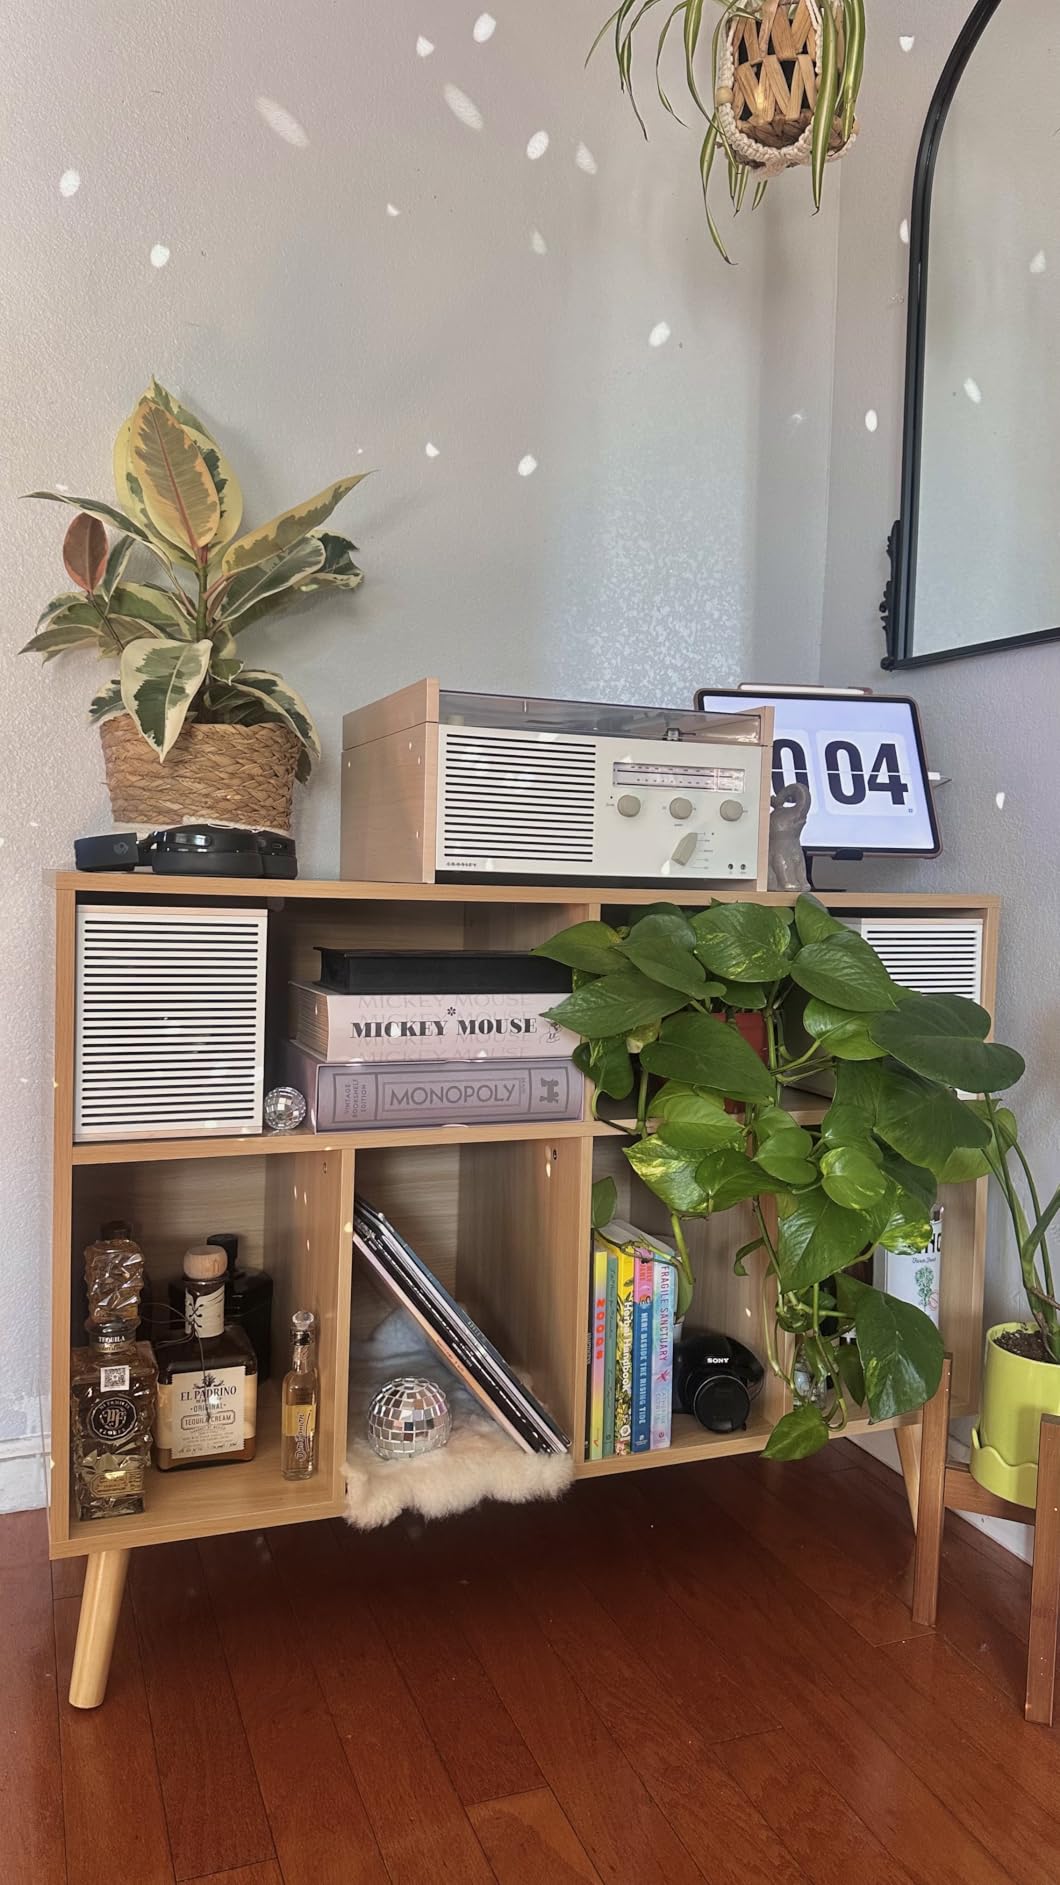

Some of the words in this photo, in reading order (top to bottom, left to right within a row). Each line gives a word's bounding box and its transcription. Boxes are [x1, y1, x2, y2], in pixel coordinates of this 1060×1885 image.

[825, 740, 908, 805] 04
[358, 995, 445, 1009] MICKEY
[454, 994, 533, 1008] MOUSE
[350, 1020, 448, 1039] MICKEY
[456, 1018, 537, 1036] MOUSE
[389, 1083, 516, 1106] MONOPOLY
[660, 1265, 669, 1304] FRAGILE
[623, 1301, 633, 1337] Herbal
[640, 1312, 649, 1332] HERE
[98, 1335, 126, 1344] TEQUILA
[658, 1307, 669, 1361] SANCTUARY
[640, 1333, 648, 1360] BESIDE
[622, 1338, 633, 1392] Handbook
[639, 1362, 648, 1377] THE
[180, 1391, 192, 1401] EL
[194, 1385, 237, 1400] PADRINO
[639, 1378, 648, 1406] RISING
[185, 1415, 210, 1426] TEQUILA
[211, 1413, 232, 1423] CREAM
[638, 1406, 648, 1424] TIDE
